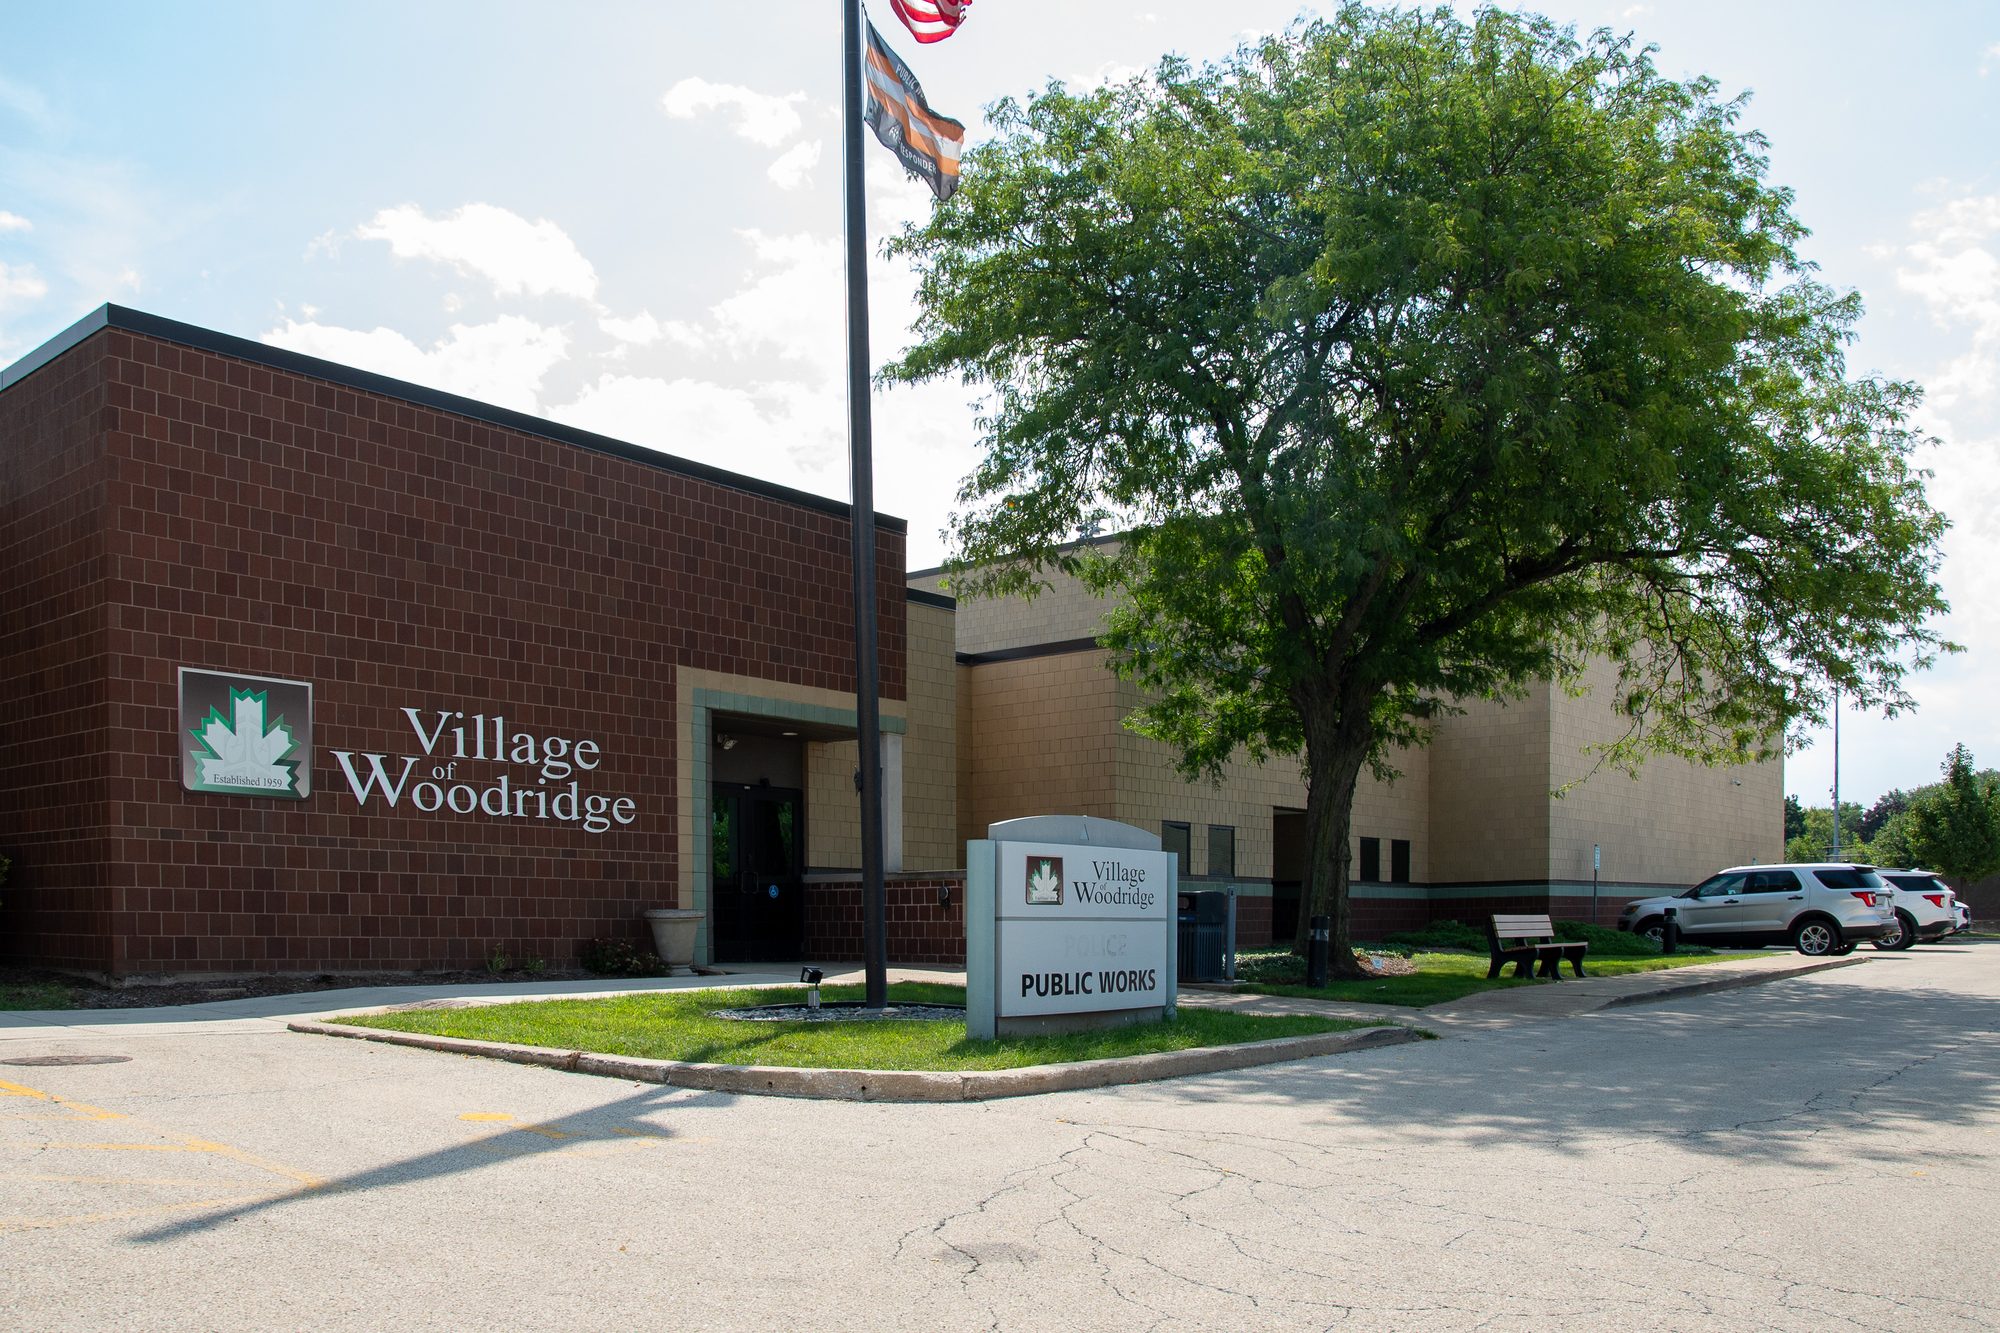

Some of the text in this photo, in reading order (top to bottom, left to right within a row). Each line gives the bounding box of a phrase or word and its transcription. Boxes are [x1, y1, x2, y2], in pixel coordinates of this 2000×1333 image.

[895, 62, 917, 90] PUBLIC
[400, 707, 601, 780] Village
[213, 773, 283, 788] Established 1959
[432, 762, 457, 781] of
[330, 750, 637, 834] Woodridge
[1092, 861, 1146, 888] Village
[1100, 882, 1108, 891] of
[1073, 881, 1155, 910] Woodridge
[1021, 968, 1156, 998] PUBLIC WORKS
